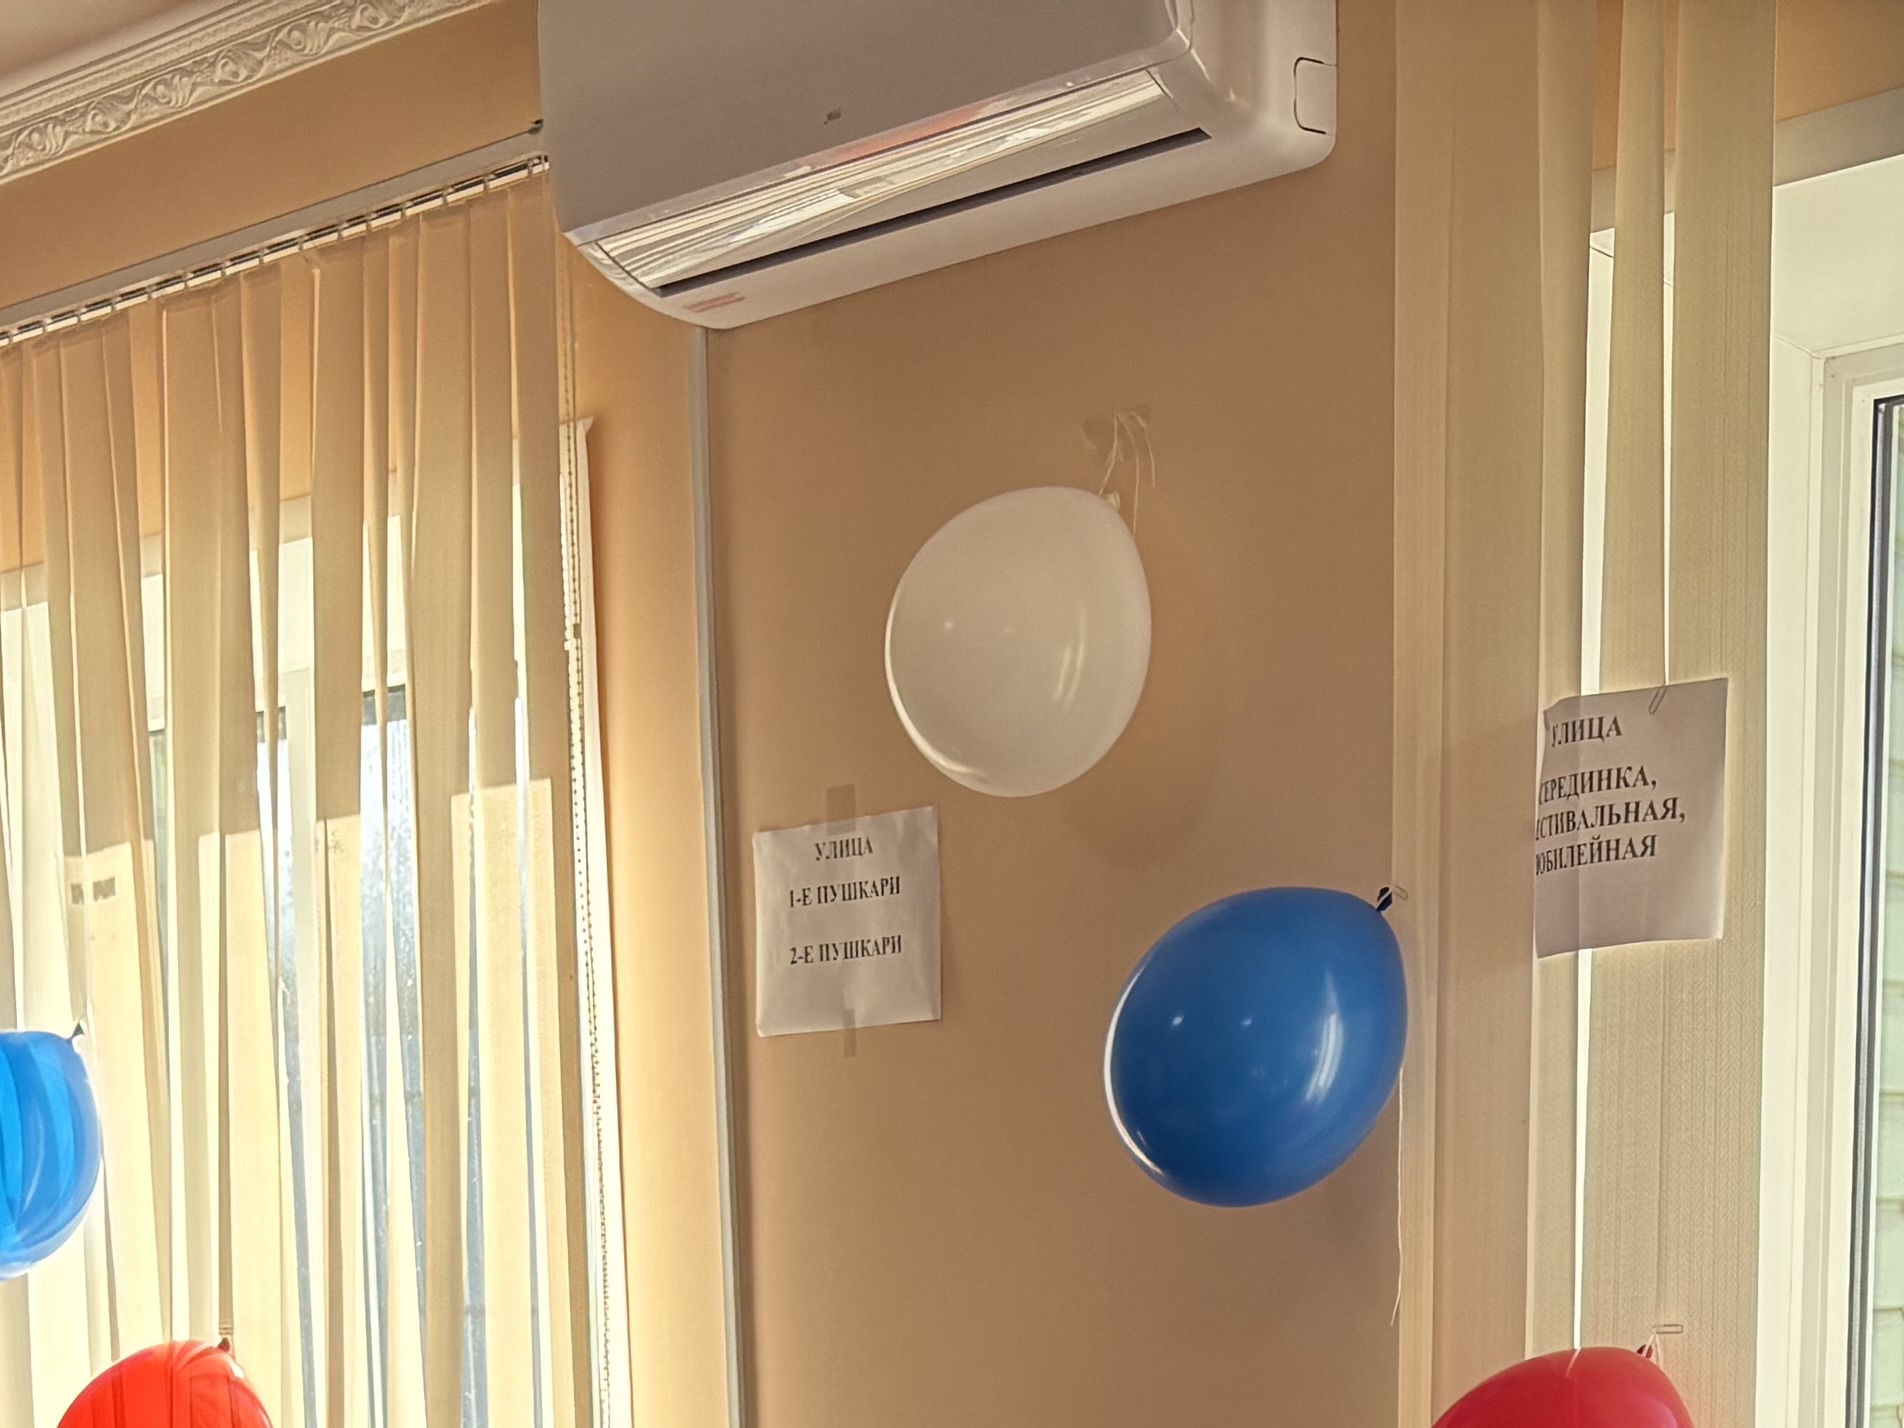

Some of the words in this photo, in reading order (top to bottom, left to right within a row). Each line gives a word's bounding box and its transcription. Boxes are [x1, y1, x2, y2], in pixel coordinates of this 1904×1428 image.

[1550, 715, 1623, 748] УЛИЦА
[814, 836, 874, 861] УЛИЦА
[788, 887, 813, 908] 1-Е
[816, 875, 902, 905] ПУШКАРИ
[789, 945, 815, 965] 2-Е
[818, 934, 903, 963] ПУШКАРИ
